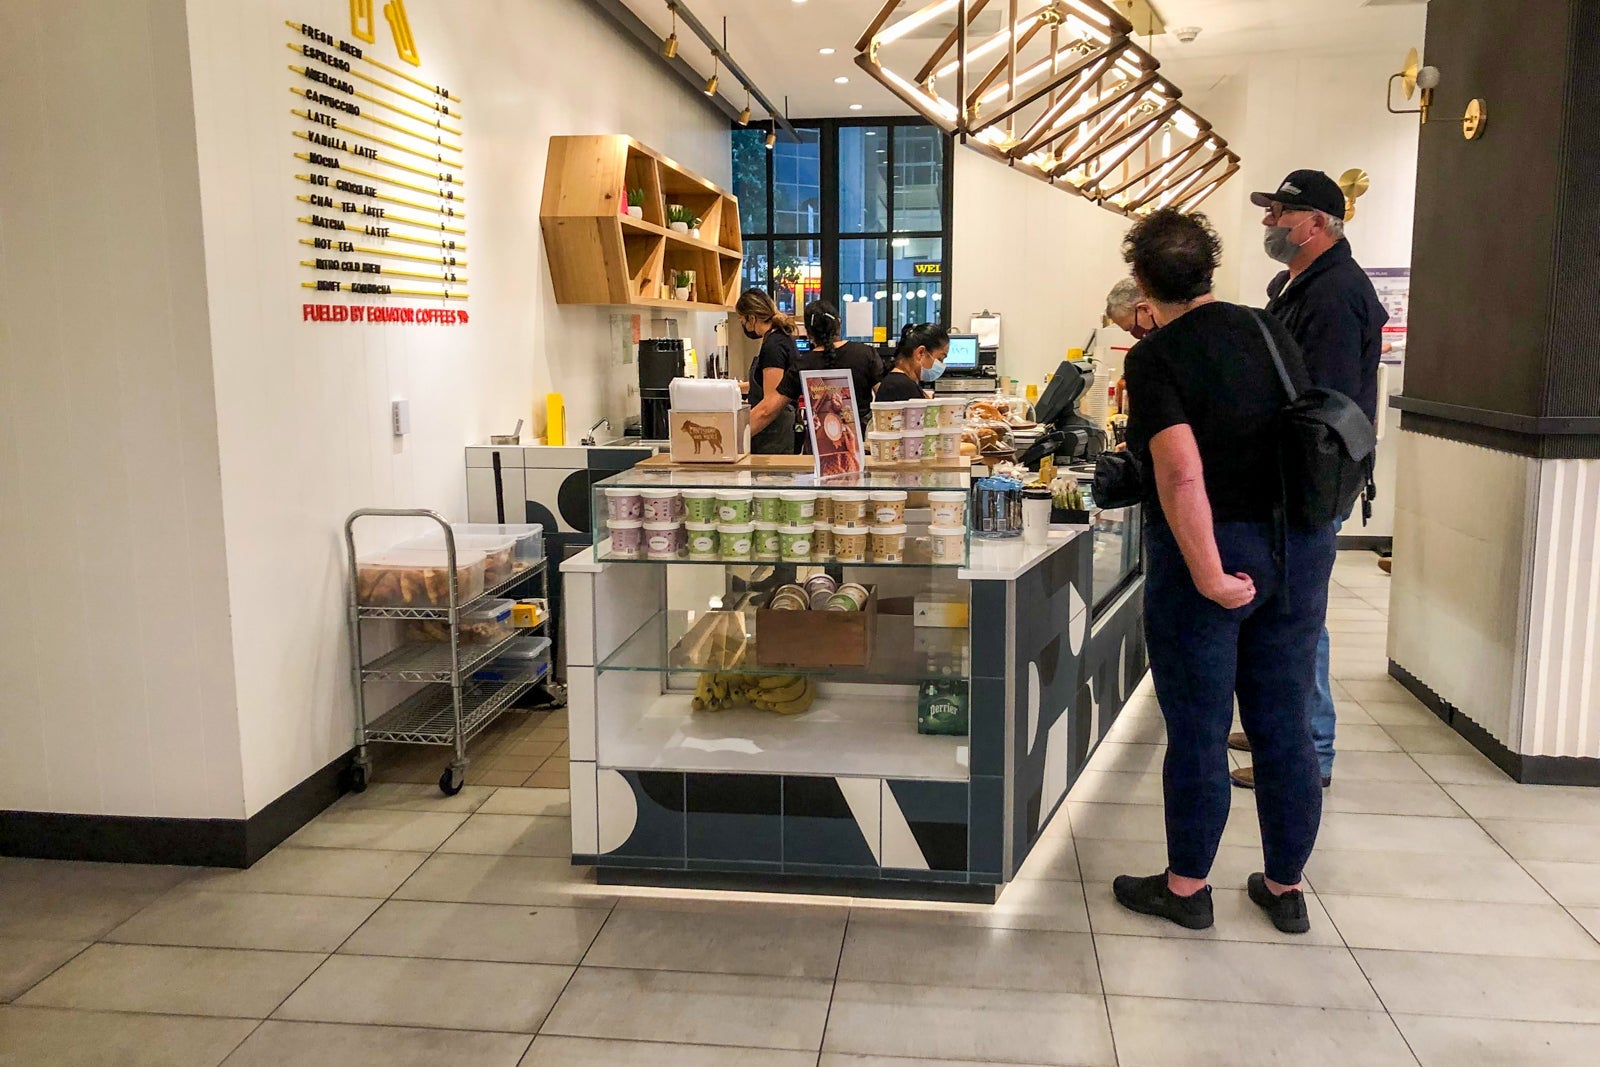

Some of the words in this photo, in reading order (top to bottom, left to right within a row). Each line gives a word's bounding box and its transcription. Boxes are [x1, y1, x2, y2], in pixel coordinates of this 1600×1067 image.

[302, 24, 333, 47] FRESH
[340, 40, 363, 60] BREW
[303, 45, 350, 72] ESPRESSO
[305, 67, 354, 95] AMERICANO
[306, 89, 360, 116] CAPPUCCINO
[307, 109, 337, 129] LATTE
[308, 131, 347, 151] VANILLA
[354, 144, 378, 160] LATTE
[309, 152, 340, 169] MOCHA
[310, 174, 329, 187] HOT
[336, 180, 377, 198] CHOCOLATE
[310, 194, 333, 208] CHAI
[341, 202, 357, 213] TEA
[363, 204, 385, 219] LATTE
[312, 214, 346, 230] MATCHA
[365, 225, 390, 238] LATTE
[314, 237, 332, 250] HOT
[338, 241, 355, 253] TEA
[315, 258, 340, 271] NITRO
[341, 261, 360, 272] COLD
[303, 304, 349, 322] FUELED
[350, 305, 366, 322] BY
[367, 306, 415, 323] EQUATOR
[416, 308, 457, 324] COFFEES
[930, 702, 958, 720] perrier
